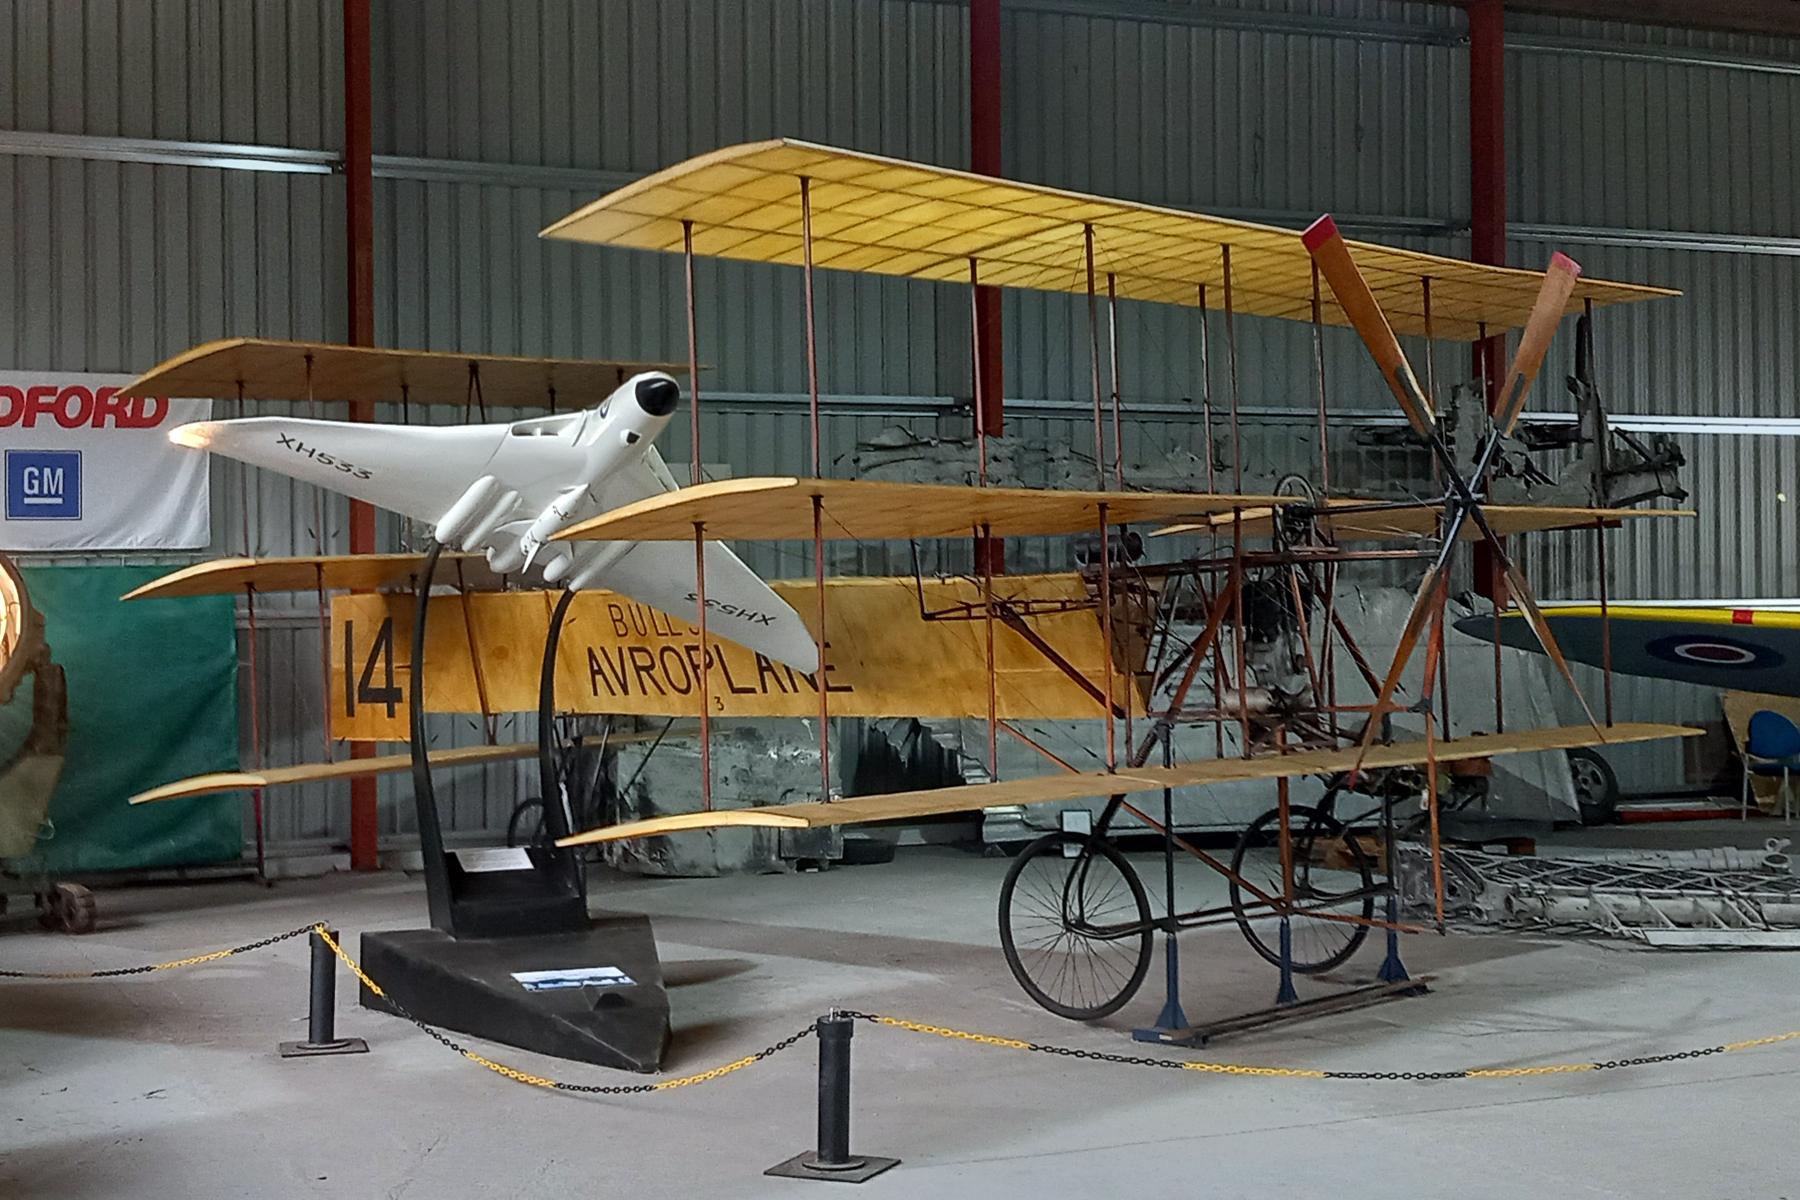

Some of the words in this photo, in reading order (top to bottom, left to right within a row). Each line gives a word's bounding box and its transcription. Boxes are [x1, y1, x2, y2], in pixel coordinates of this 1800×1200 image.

[276, 432, 373, 480] XH533
[23, 466, 64, 495] GM
[608, 604, 700, 638] BULL
[345, 617, 403, 718] 14
[714, 696, 725, 711] 3
